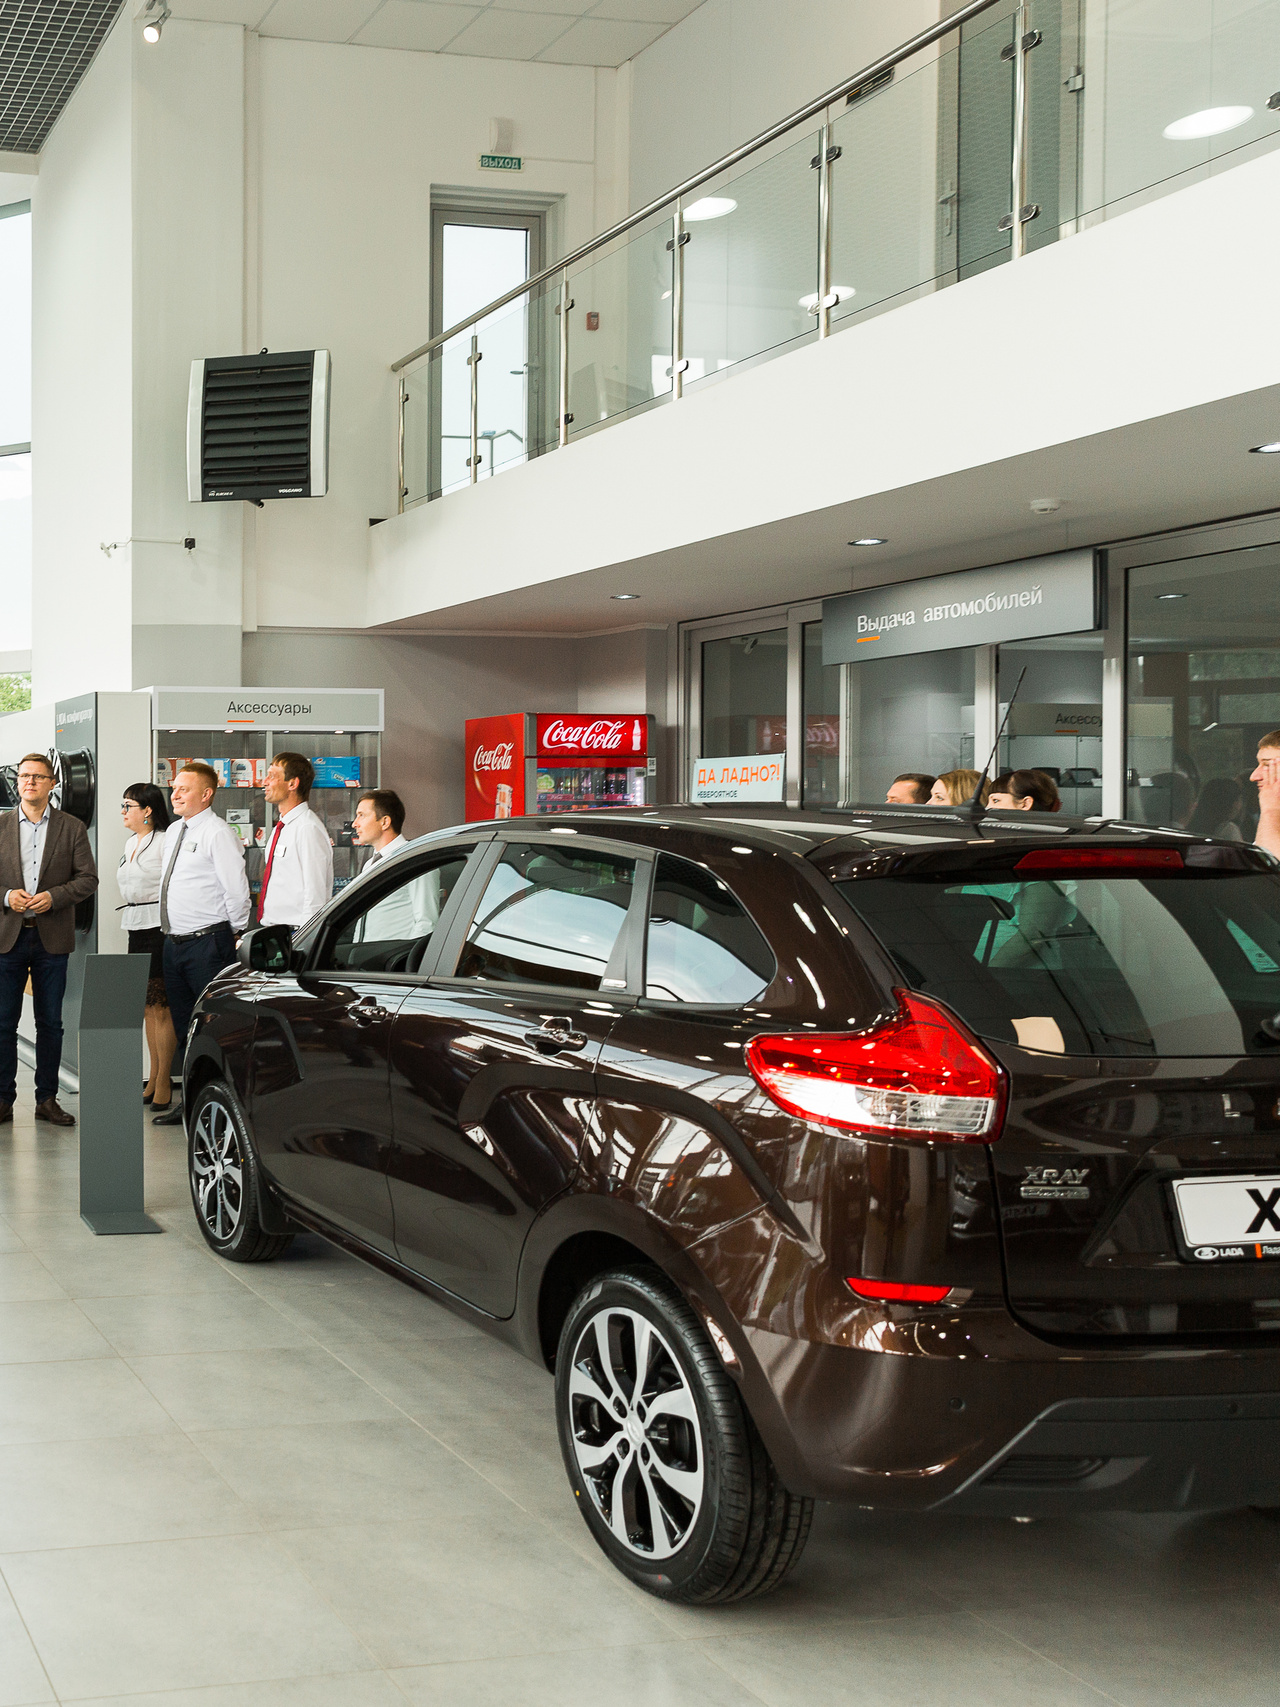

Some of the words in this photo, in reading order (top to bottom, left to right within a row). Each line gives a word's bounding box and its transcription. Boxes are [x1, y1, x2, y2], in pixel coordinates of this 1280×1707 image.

[482, 157, 519, 169] ВЫХОД
[857, 610, 916, 633] Выдача
[923, 585, 1043, 623] автомобилей
[227, 701, 312, 716] Аксессуары
[1055, 713, 1103, 728] Аксессу
[542, 719, 626, 749] Coca-Cola
[473, 742, 514, 771] Coca-Cola
[697, 768, 716, 787] ДА
[720, 763, 780, 785] ЛАДНО?!
[697, 790, 738, 799] НЕВЕРОЯТНОЕ
[1021, 1166, 1090, 1184] XRAY
[1220, 1247, 1244, 1257] LADA
